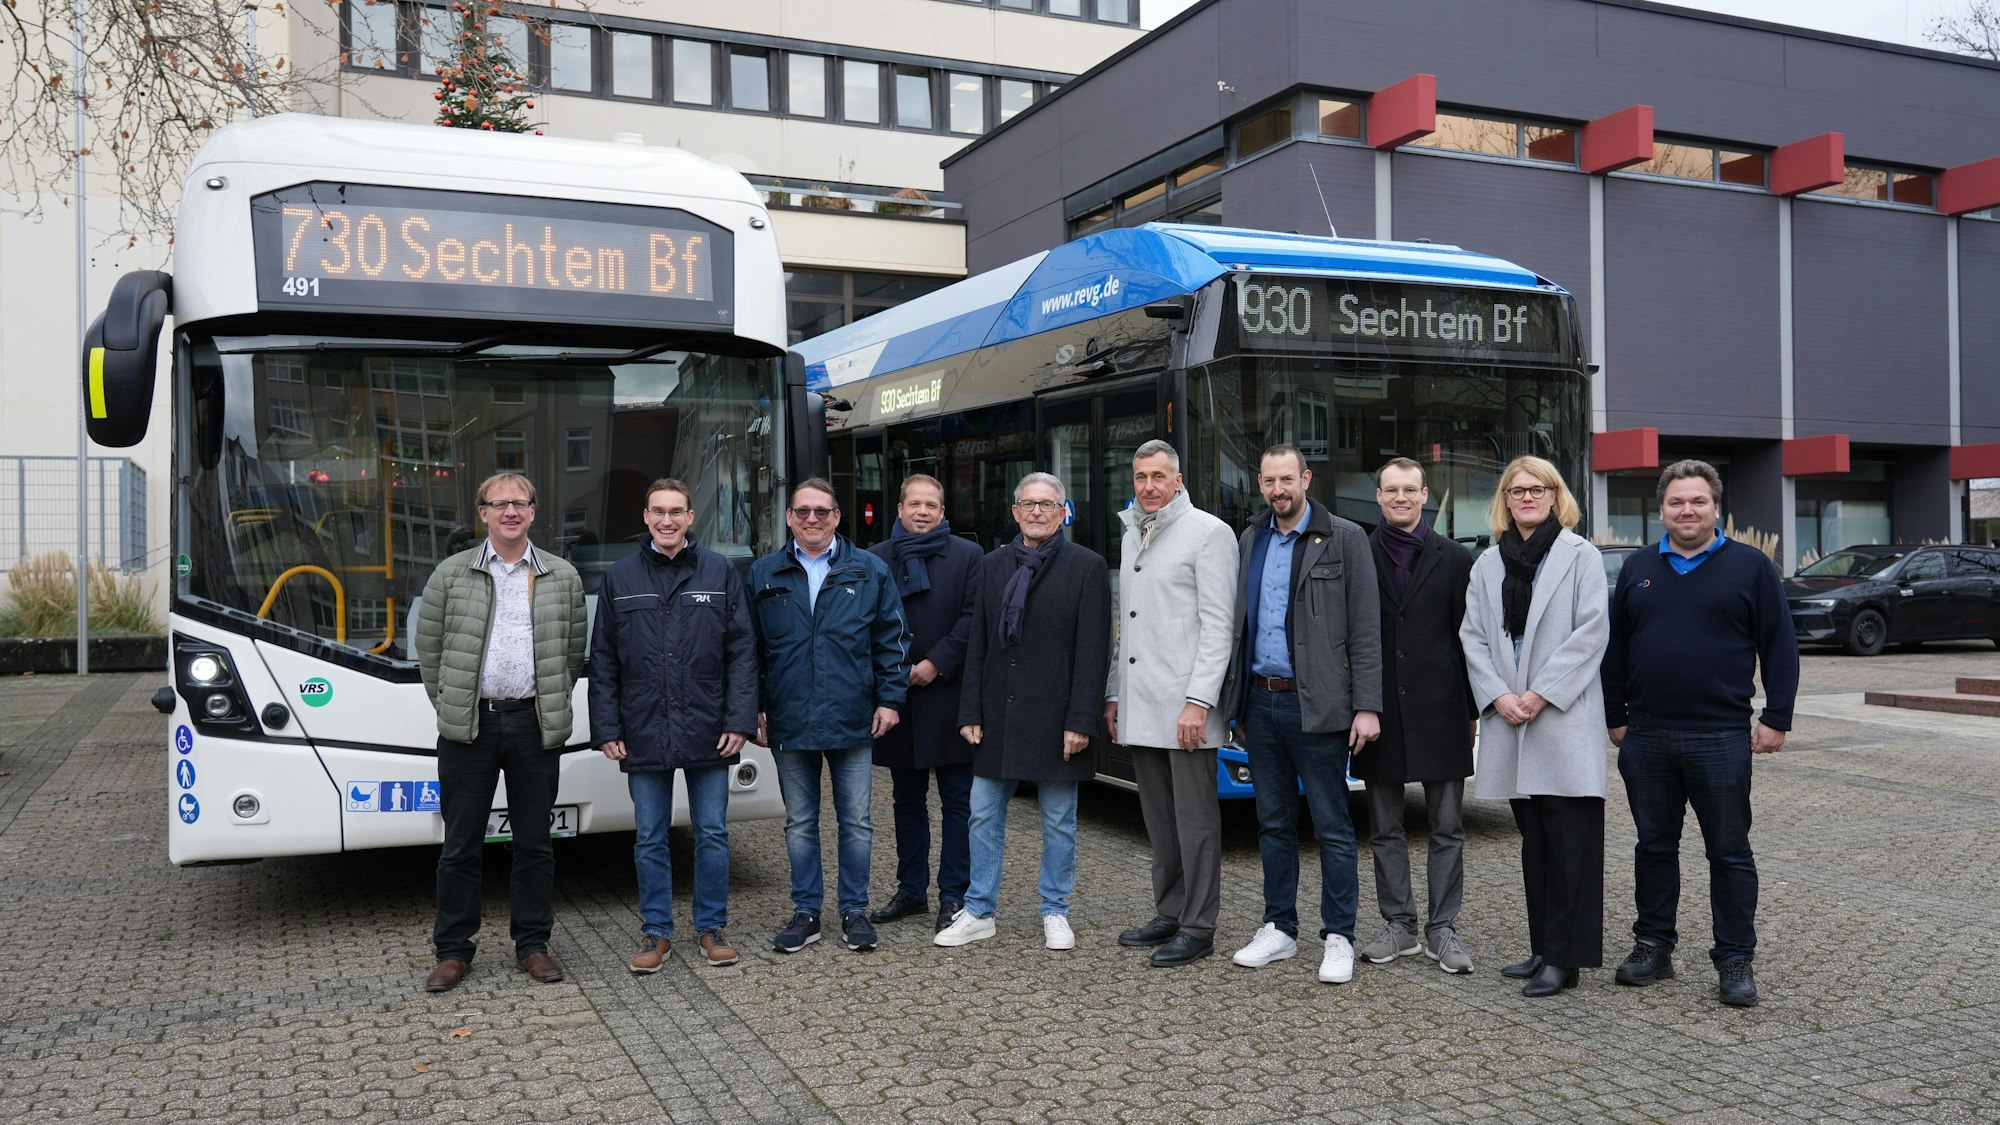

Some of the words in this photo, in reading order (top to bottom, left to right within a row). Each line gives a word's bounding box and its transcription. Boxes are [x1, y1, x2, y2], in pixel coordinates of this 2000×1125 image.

[284, 208, 386, 276] 730
[402, 217, 625, 290] Sechtem
[650, 234, 702, 294] Bf
[282, 277, 320, 297] 491
[1042, 275, 1119, 314] www.revg.de
[1242, 284, 1311, 336] 930
[1339, 294, 1483, 342] Sechtem
[1493, 304, 1528, 344] Bf
[881, 388, 896, 414] 930
[896, 384, 930, 409] Sechtem
[931, 379, 942, 402] Bf
[299, 683, 325, 694] VRS
